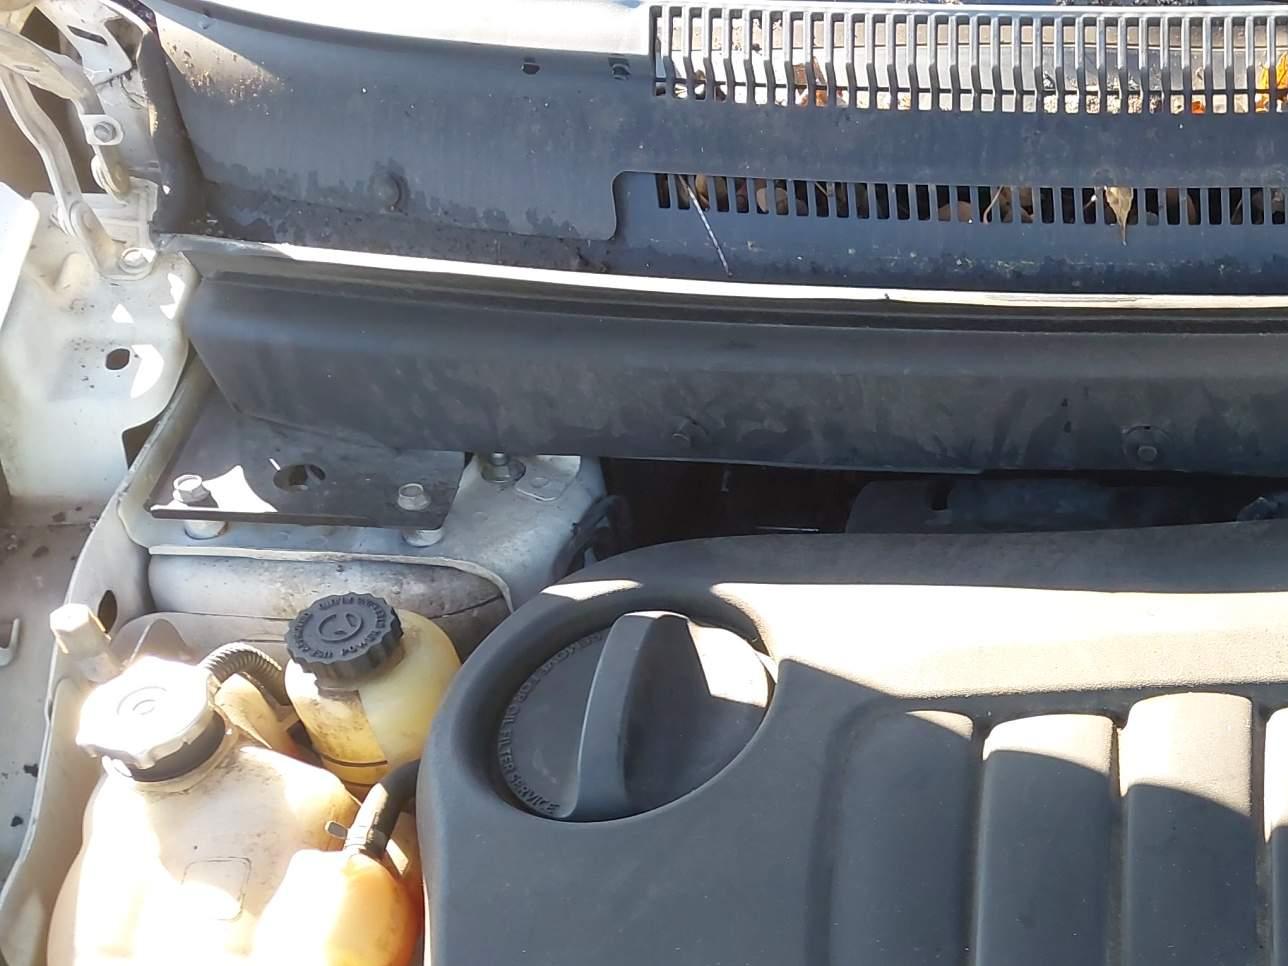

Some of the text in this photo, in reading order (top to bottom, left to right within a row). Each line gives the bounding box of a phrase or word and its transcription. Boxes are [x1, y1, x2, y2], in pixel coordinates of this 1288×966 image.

[501, 703, 521, 726] OIL
[497, 728, 515, 773] FILTER
[510, 771, 561, 814] SERVICE
